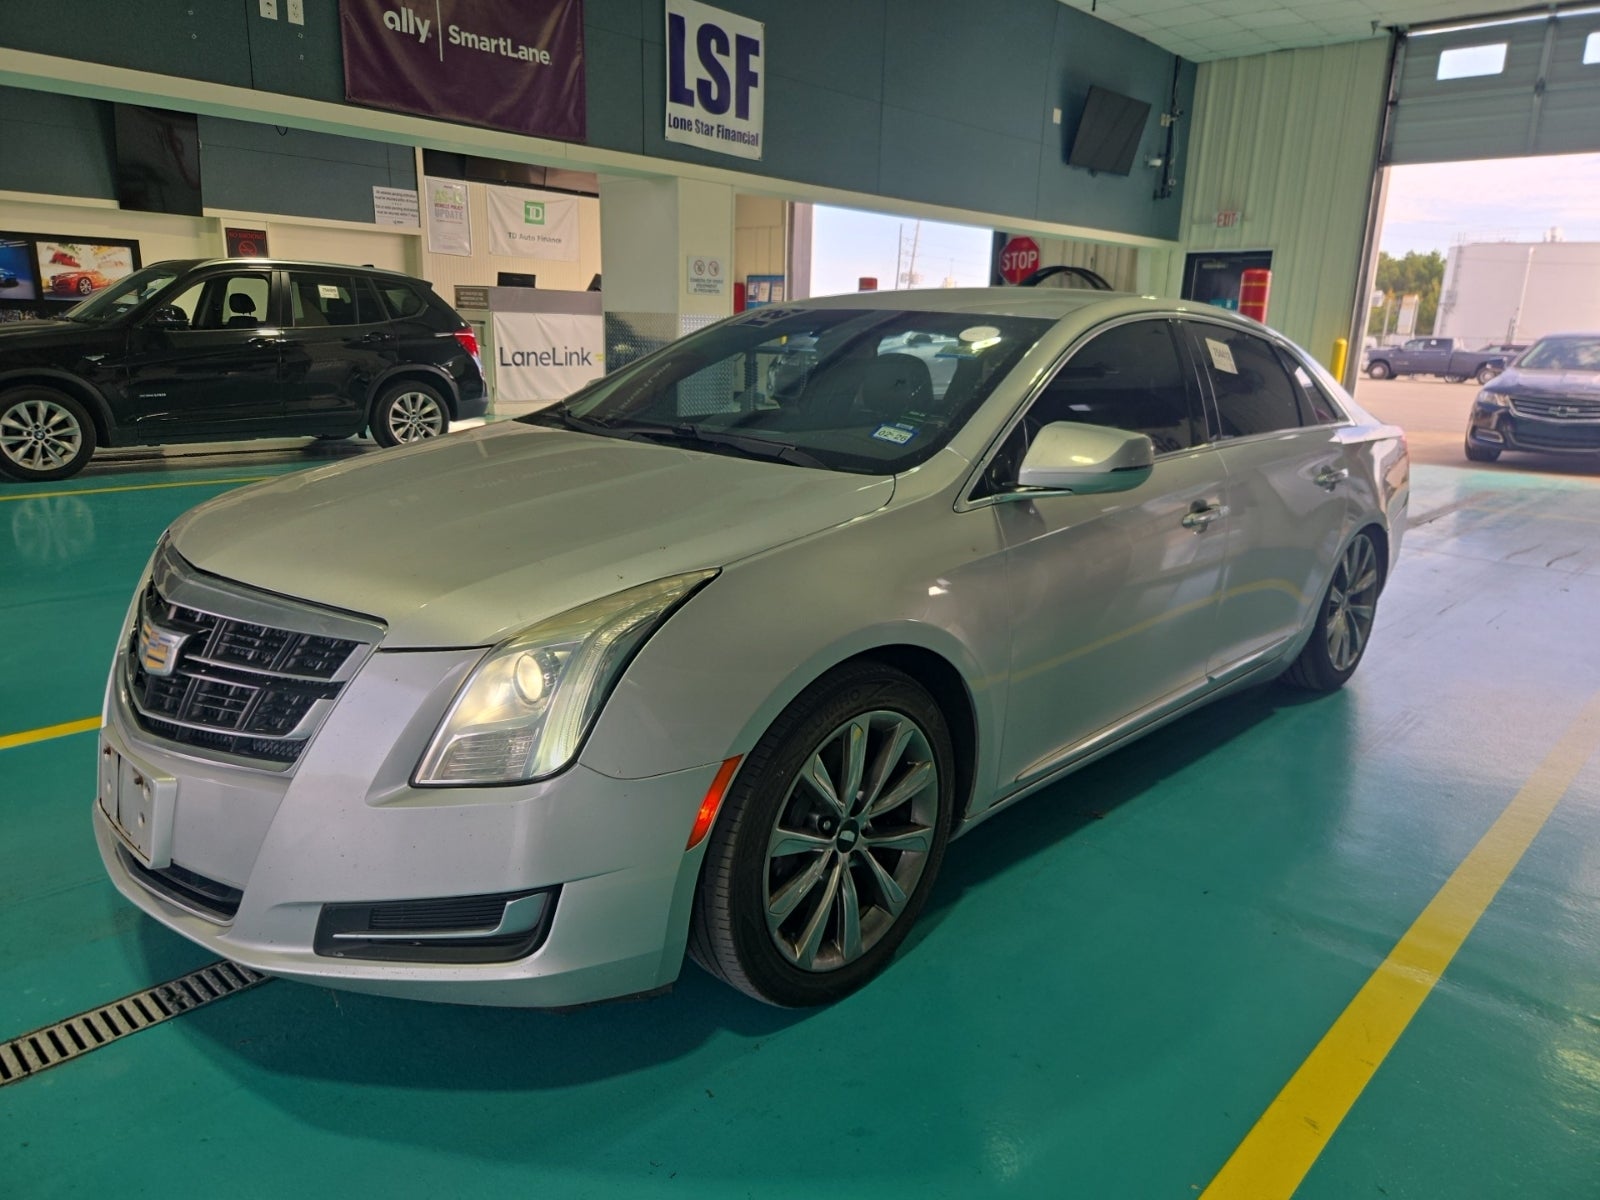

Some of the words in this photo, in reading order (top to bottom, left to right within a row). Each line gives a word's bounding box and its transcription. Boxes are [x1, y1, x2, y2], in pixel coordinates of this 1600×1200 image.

[383, 6, 430, 44] ally
[448, 25, 550, 65] SmartLane
[668, 12, 760, 121] LSF
[668, 113, 693, 131] Lone
[695, 119, 714, 138] Star
[716, 124, 759, 147] Financial
[434, 208, 464, 219] UPDATE
[526, 204, 544, 221] TD
[1216, 212, 1237, 227] EXIT
[519, 233, 536, 241] Auto
[1002, 251, 1037, 271] STOP
[500, 346, 592, 367] LaneLink
